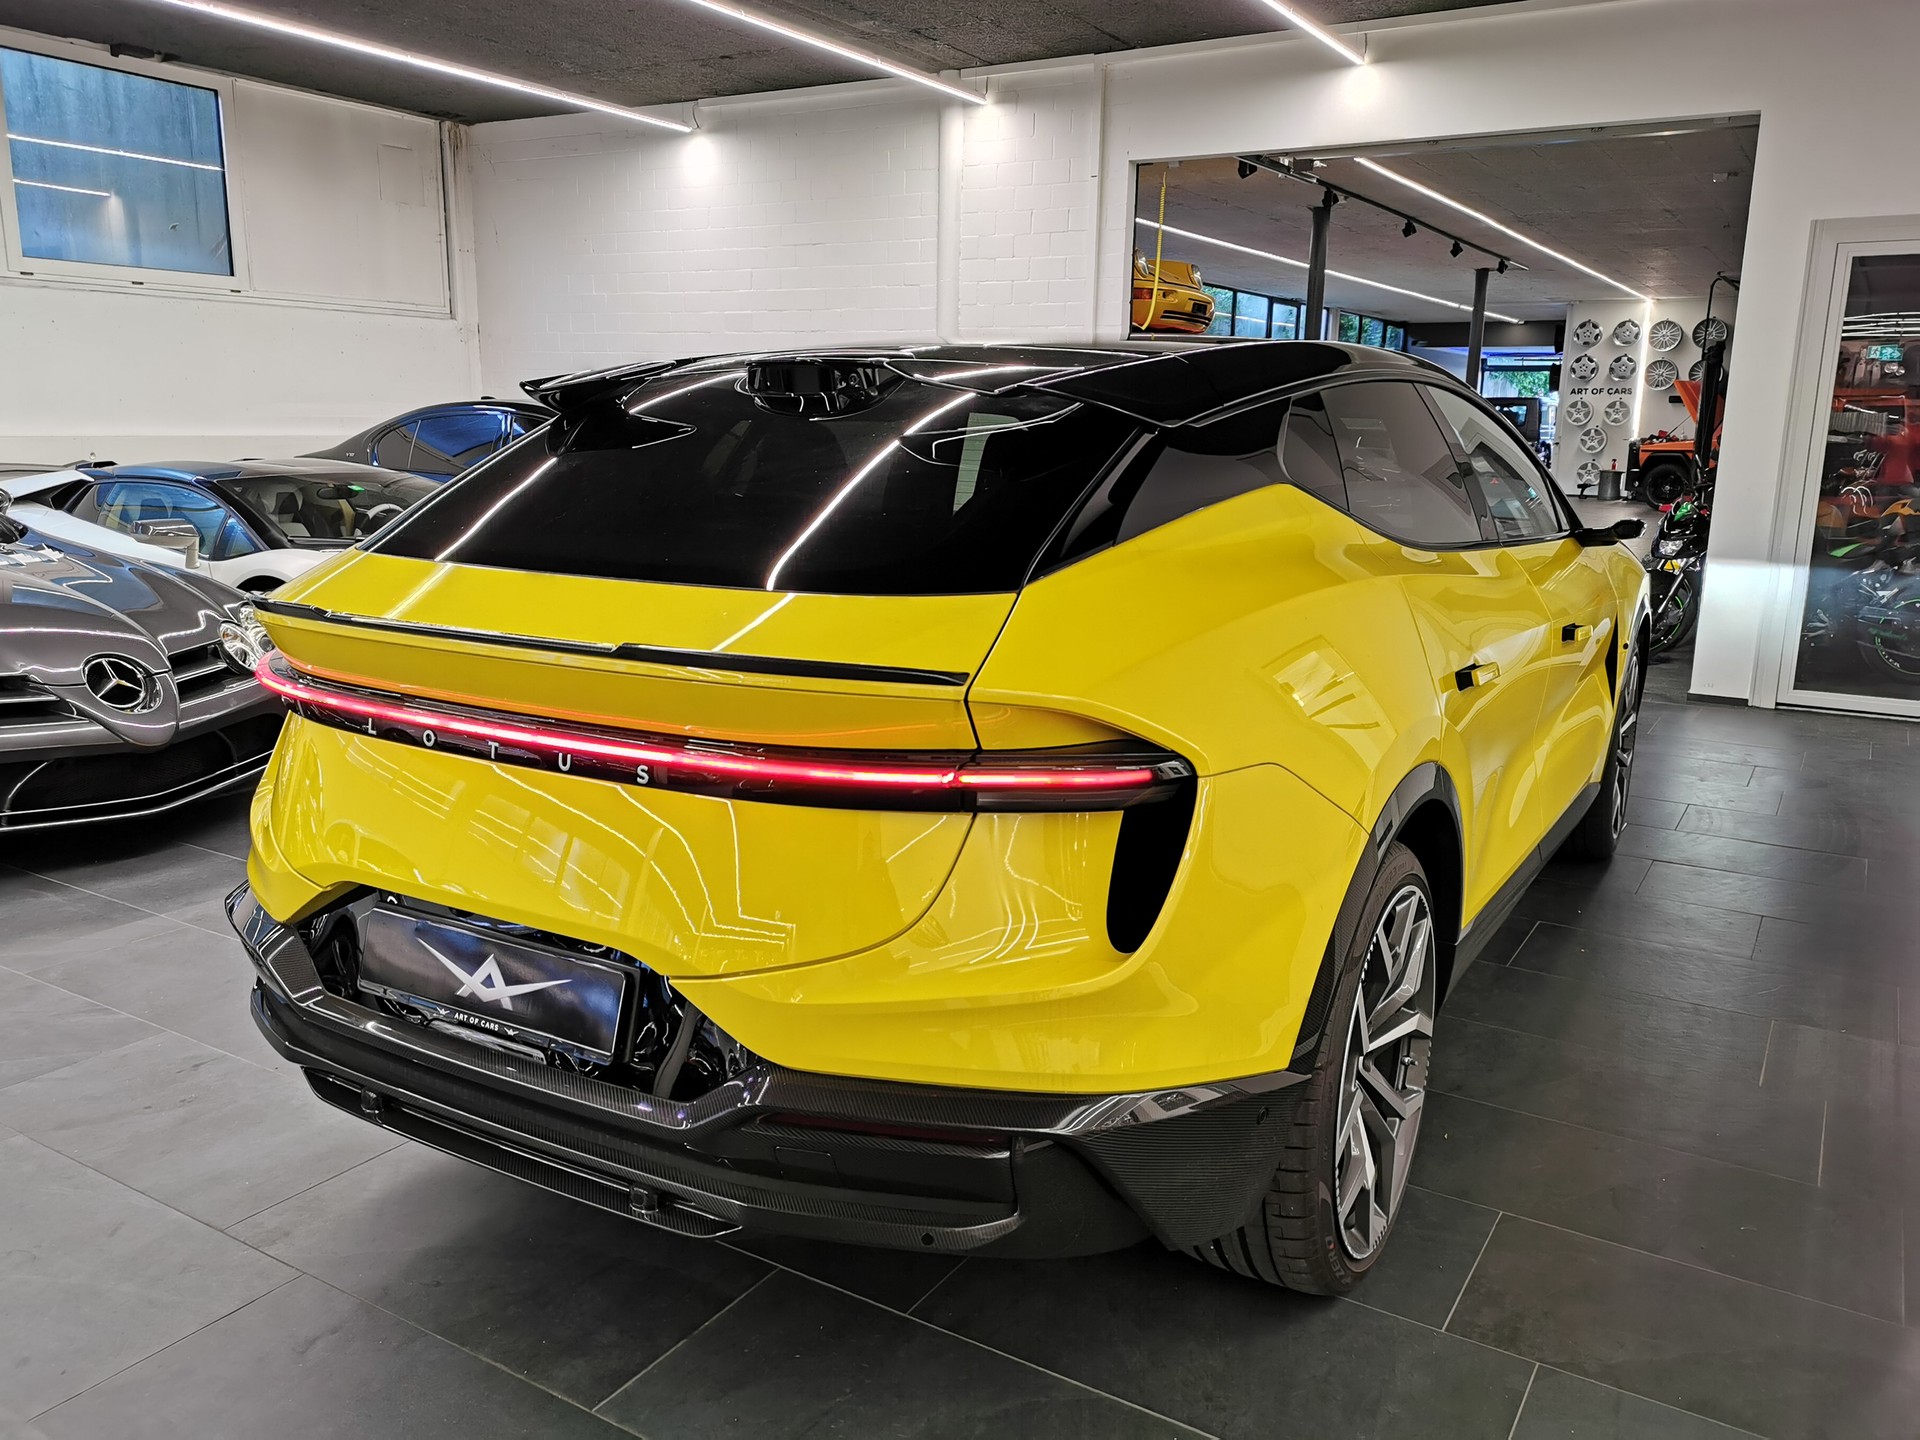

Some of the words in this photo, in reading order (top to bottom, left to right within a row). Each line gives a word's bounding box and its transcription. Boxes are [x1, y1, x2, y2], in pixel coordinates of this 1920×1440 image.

[1570, 387, 1589, 395] ART
[1591, 387, 1605, 395] OF
[1606, 387, 1633, 395] CARS
[367, 717, 650, 785] LOTUS
[454, 1012, 468, 1022] ART
[469, 1016, 479, 1025] OF
[480, 1020, 499, 1031] CARS
[1325, 1235, 1345, 1279] ZERO
